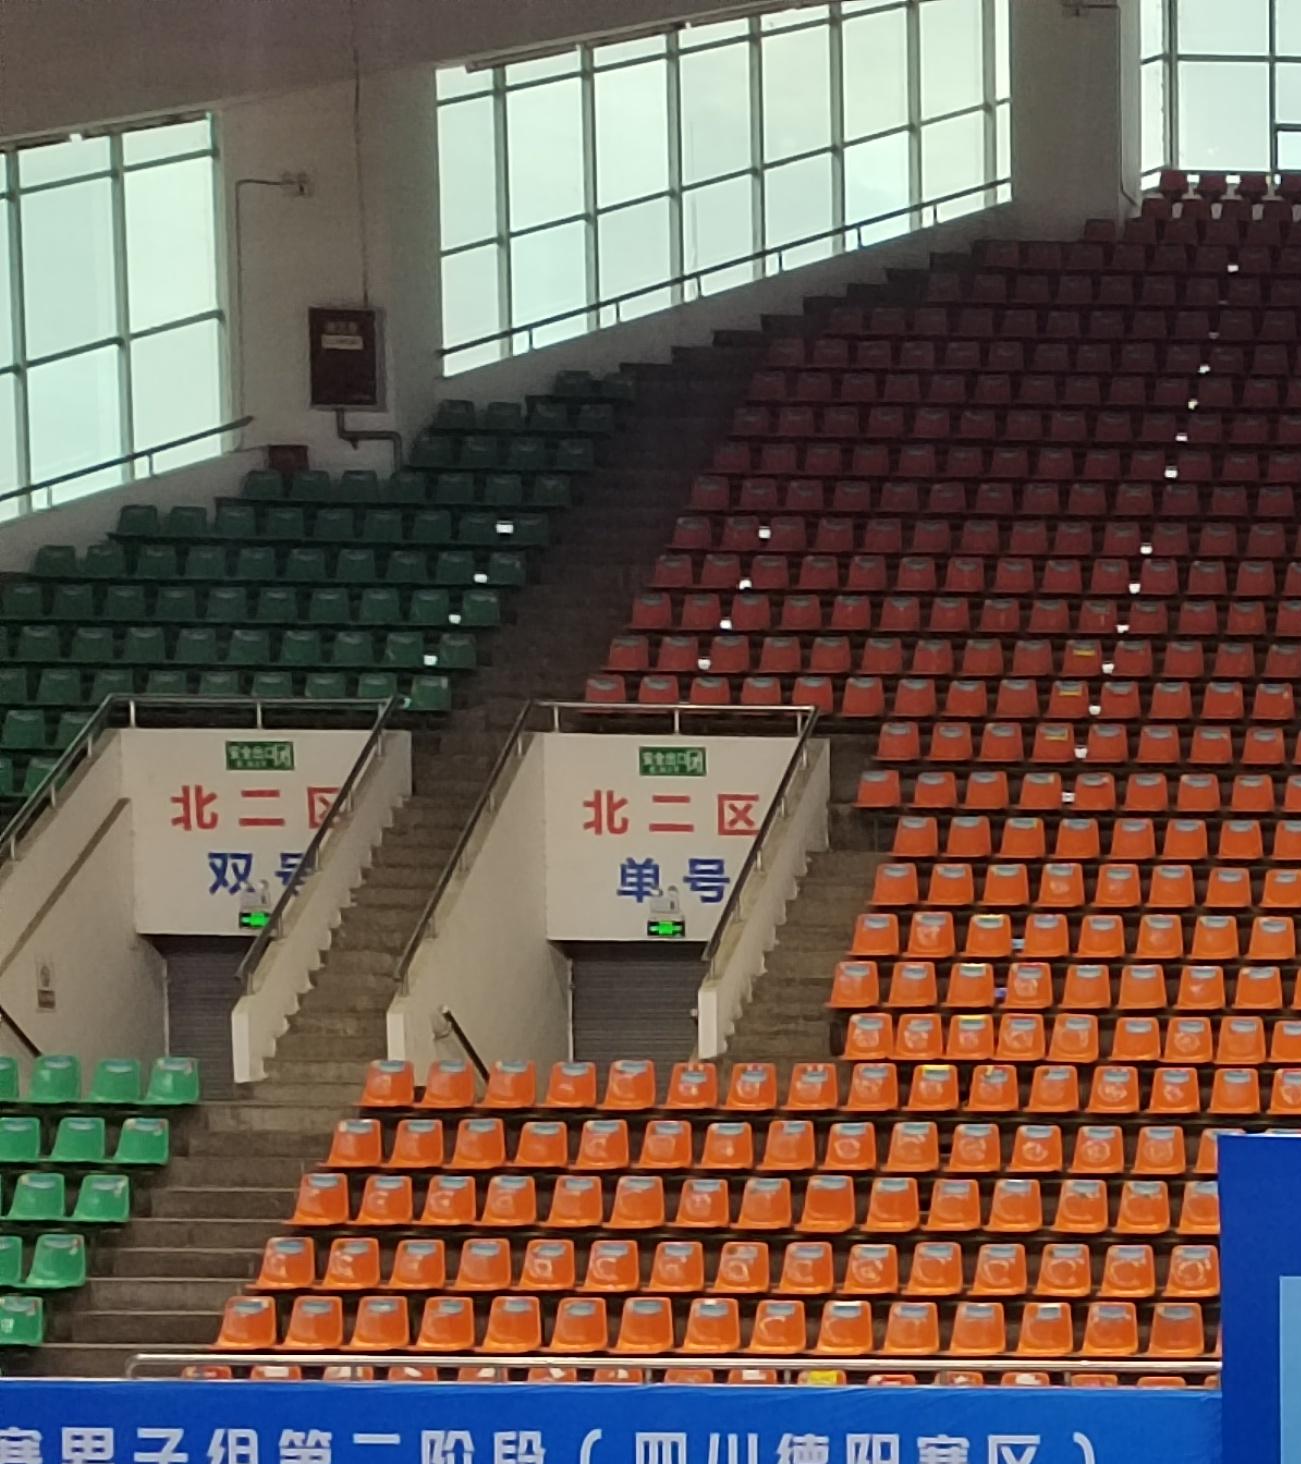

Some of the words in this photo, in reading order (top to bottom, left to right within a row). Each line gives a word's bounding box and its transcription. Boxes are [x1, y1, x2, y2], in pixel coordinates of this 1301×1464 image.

[583, 790, 762, 836] 北二区
[617, 857, 731, 904] 单号
